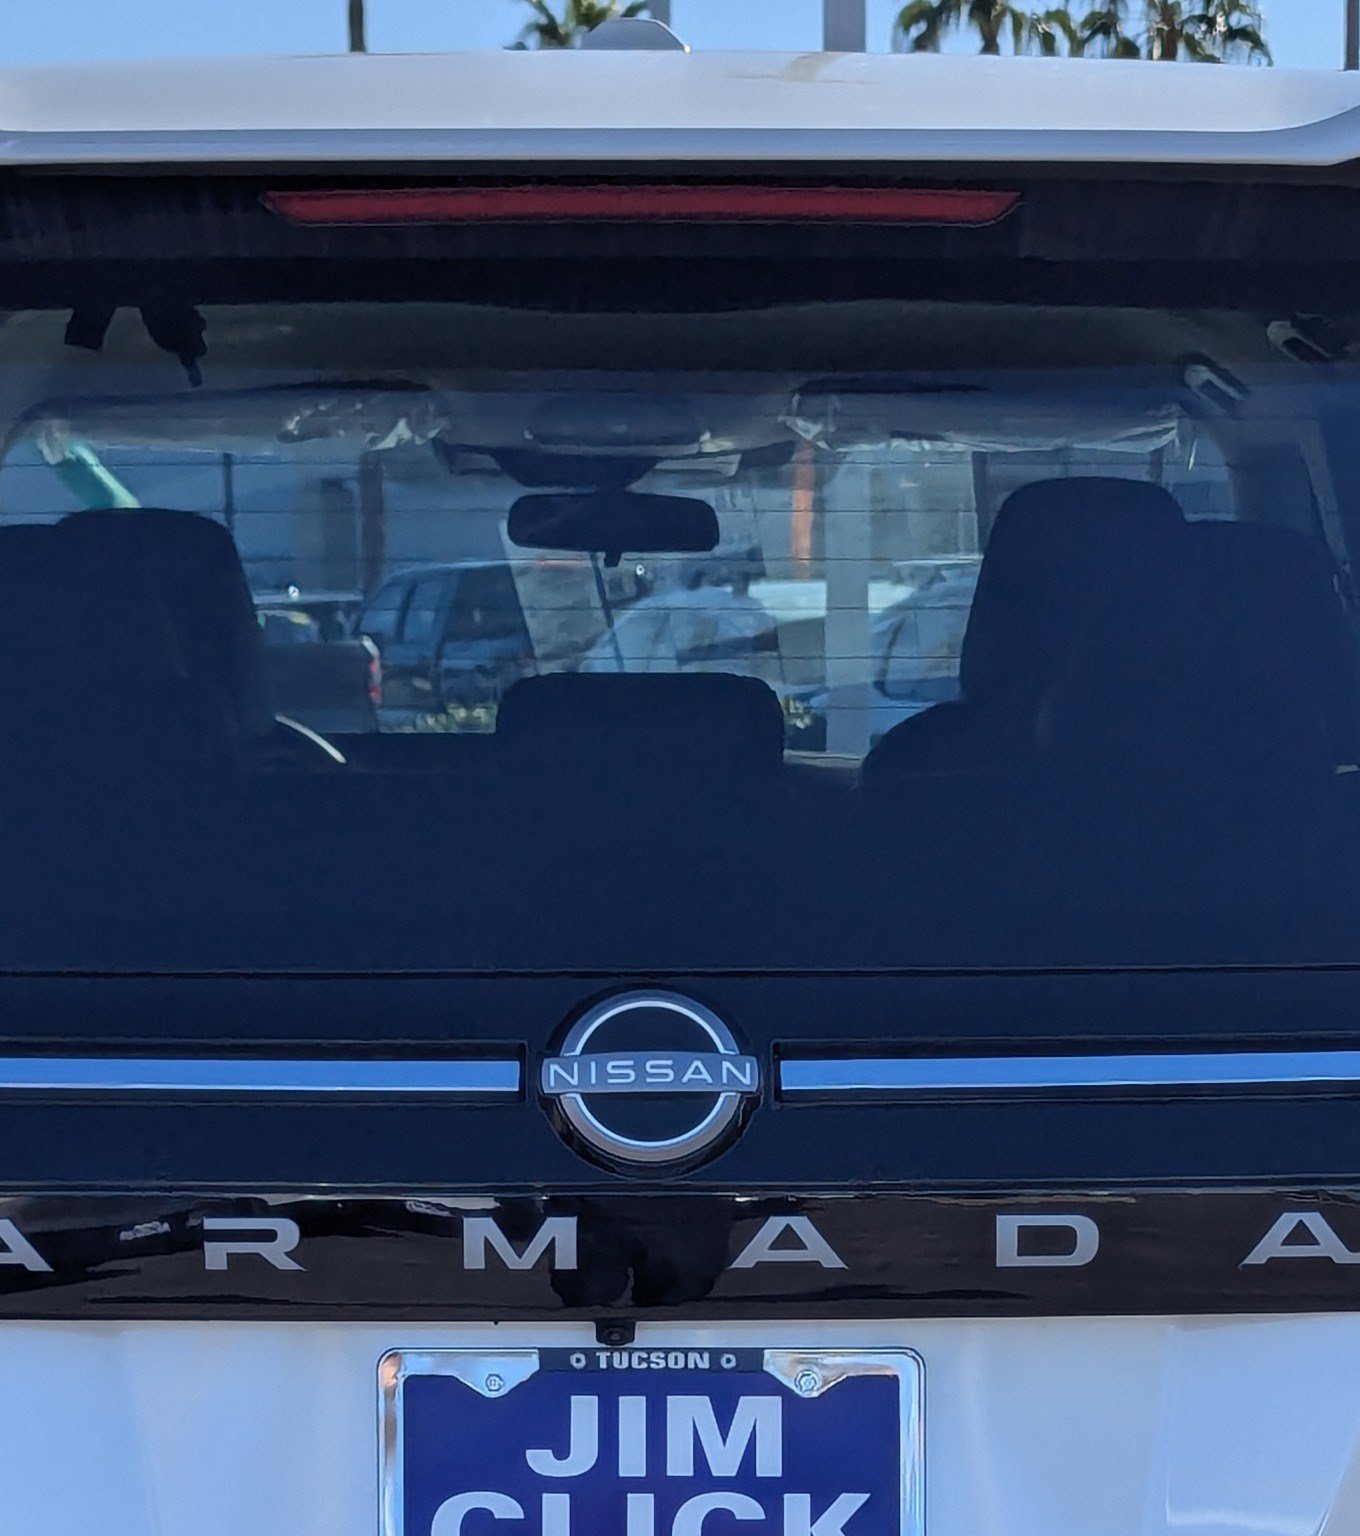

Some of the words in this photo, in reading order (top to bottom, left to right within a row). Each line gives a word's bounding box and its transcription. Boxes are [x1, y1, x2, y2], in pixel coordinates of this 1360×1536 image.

[549, 1058, 751, 1087] NISSAN
[596, 1351, 711, 1370] TUCSON
[525, 1394, 783, 1478] JIM
